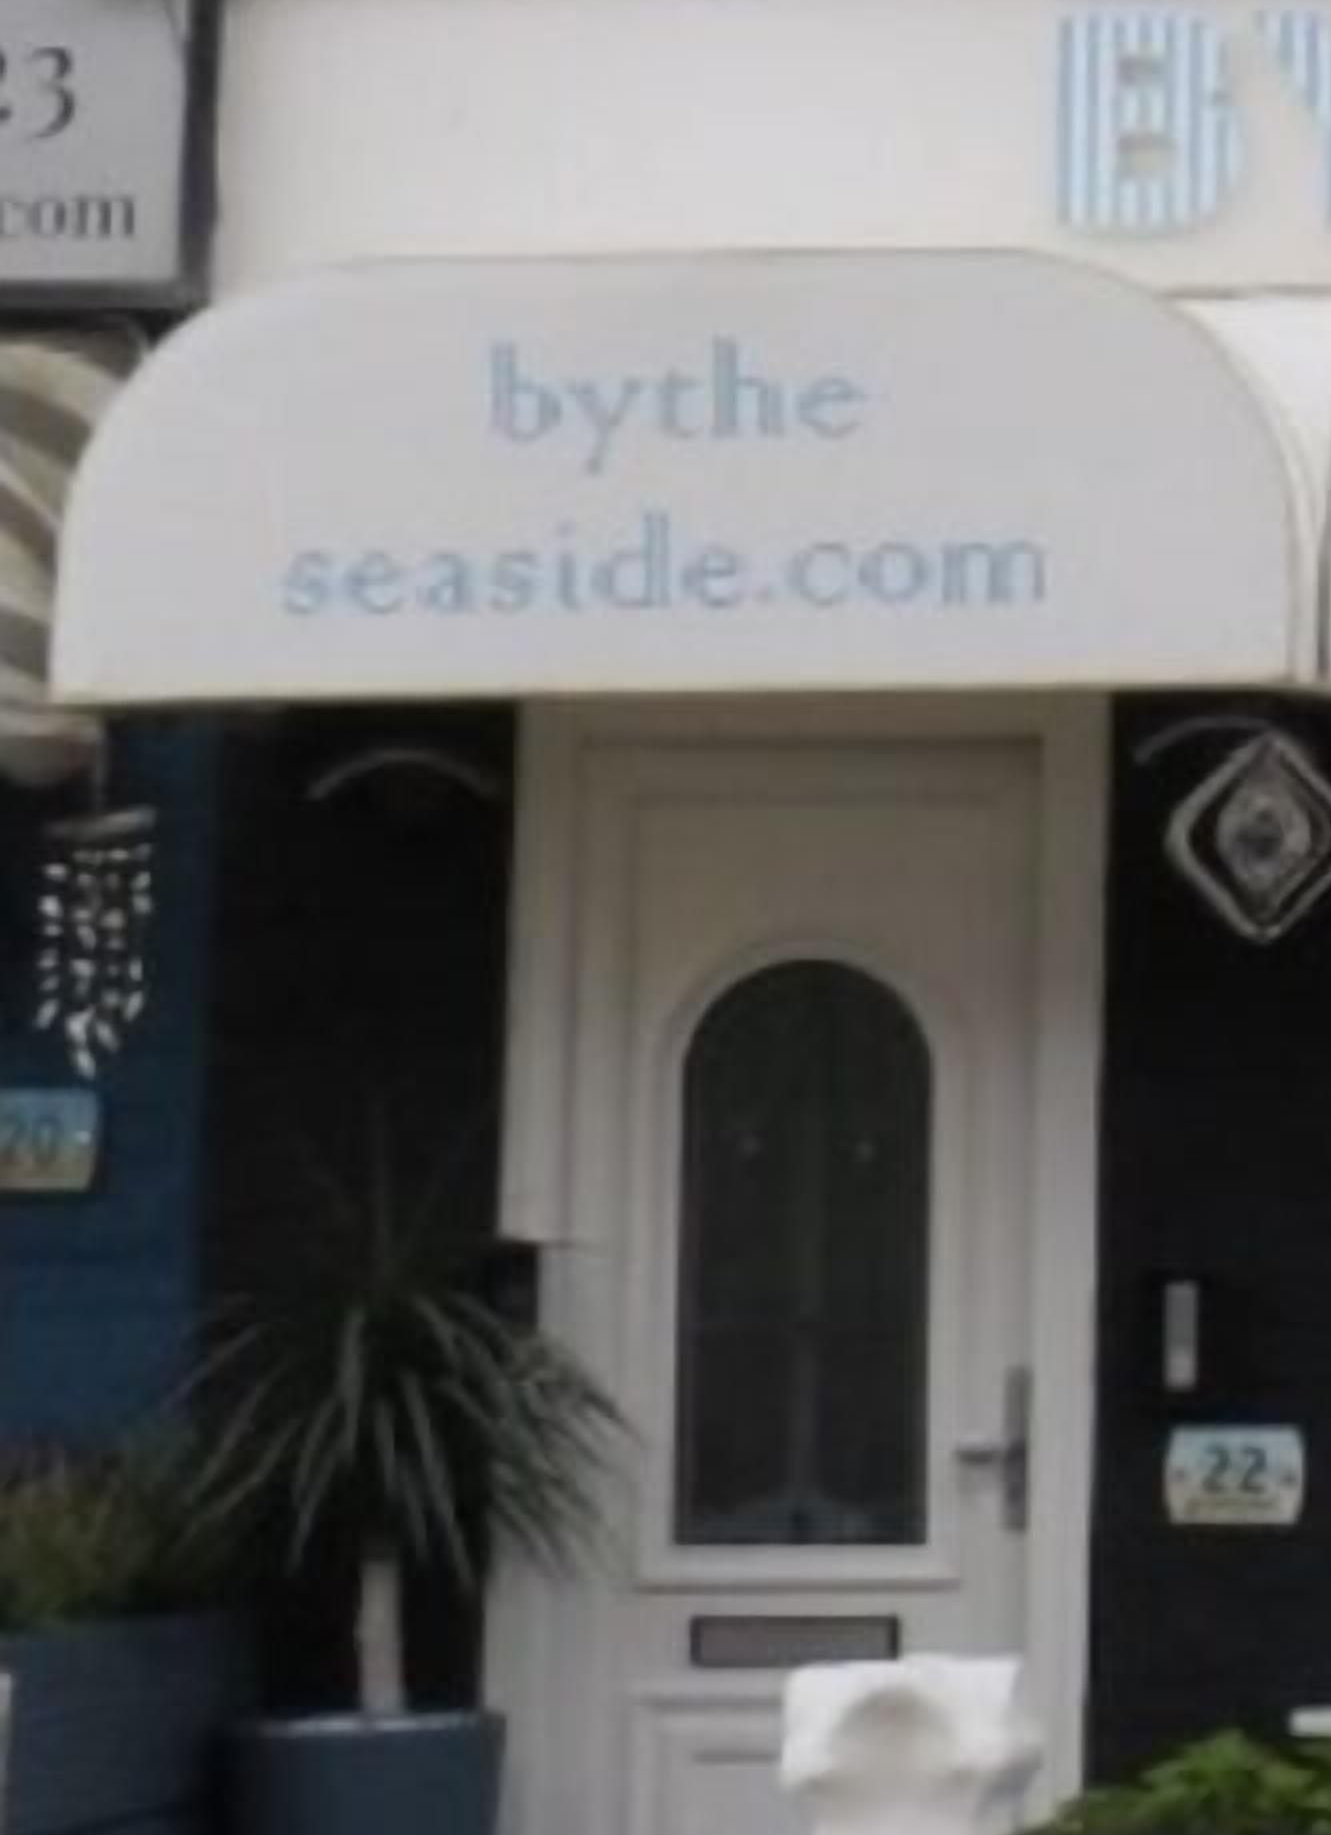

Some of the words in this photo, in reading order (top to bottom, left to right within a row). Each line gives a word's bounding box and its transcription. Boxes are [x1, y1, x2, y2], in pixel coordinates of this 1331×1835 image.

[488, 340, 872, 475] bythe
[280, 512, 1050, 618] seaside.com
[1200, 1440, 1268, 1493] 22
